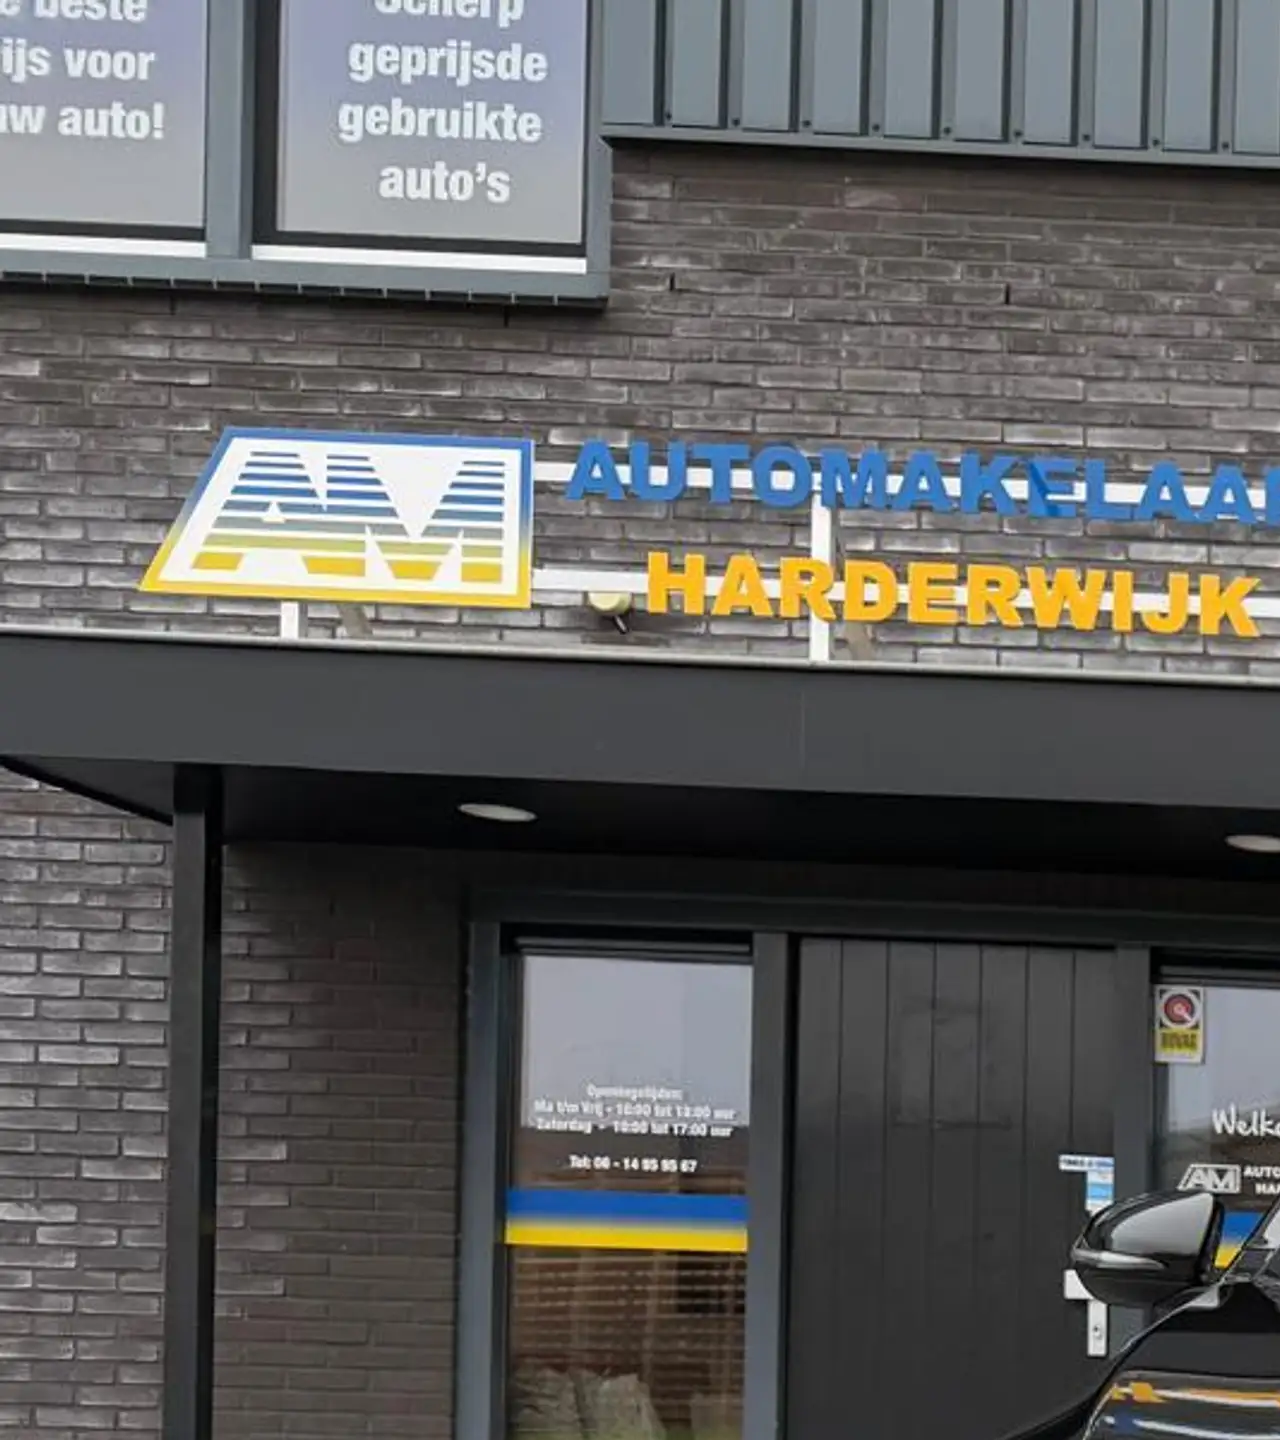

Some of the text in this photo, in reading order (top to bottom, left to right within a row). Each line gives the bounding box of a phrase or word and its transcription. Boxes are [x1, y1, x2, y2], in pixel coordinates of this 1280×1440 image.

[64, 48, 156, 80] voor
[348, 39, 548, 86] geprijsde
[57, 101, 165, 140] auto!
[338, 98, 543, 142] gebruikte
[378, 161, 511, 203] auto's
[647, 551, 1262, 638] HARDERWIJK
